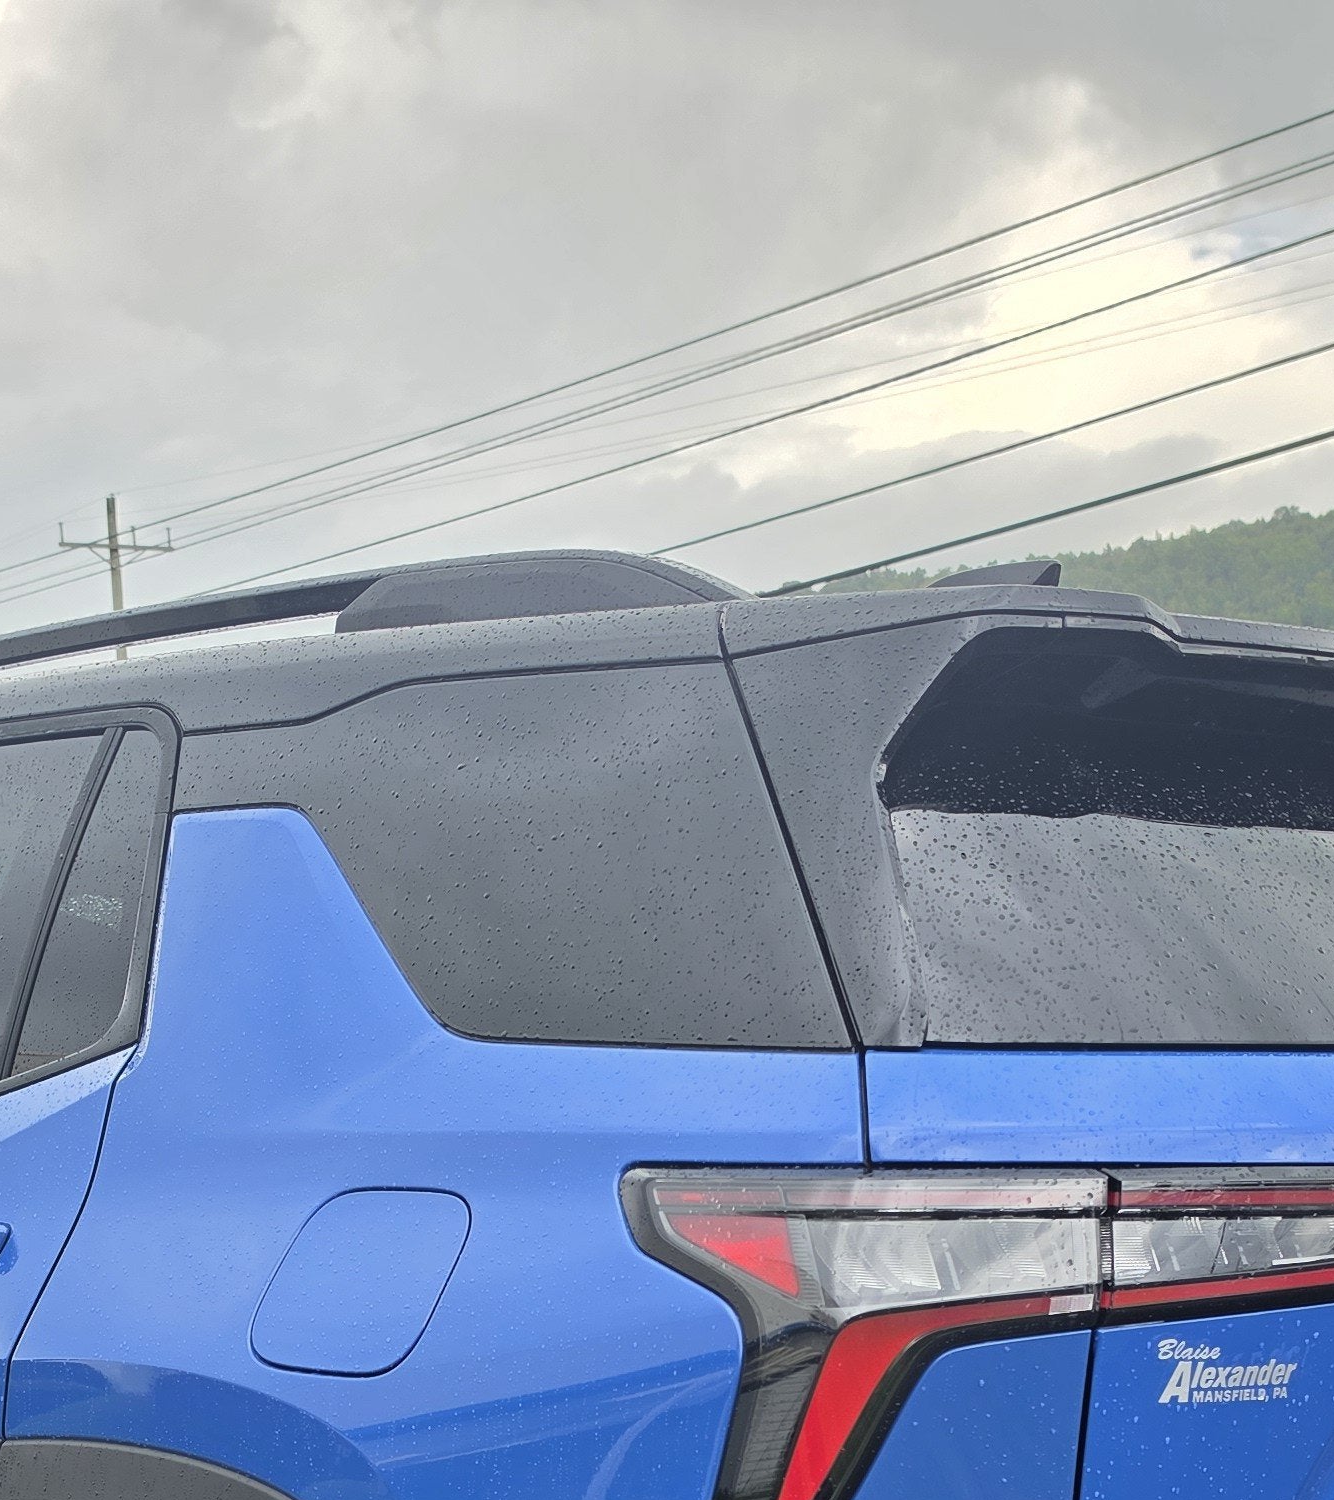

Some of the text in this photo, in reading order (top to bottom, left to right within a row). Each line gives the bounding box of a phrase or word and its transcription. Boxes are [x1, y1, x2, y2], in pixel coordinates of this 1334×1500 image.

[1157, 1338, 1221, 1360] Blaise
[1158, 1358, 1298, 1404] Alexander
[1192, 1386, 1288, 1403] MANSFIELD, PA
